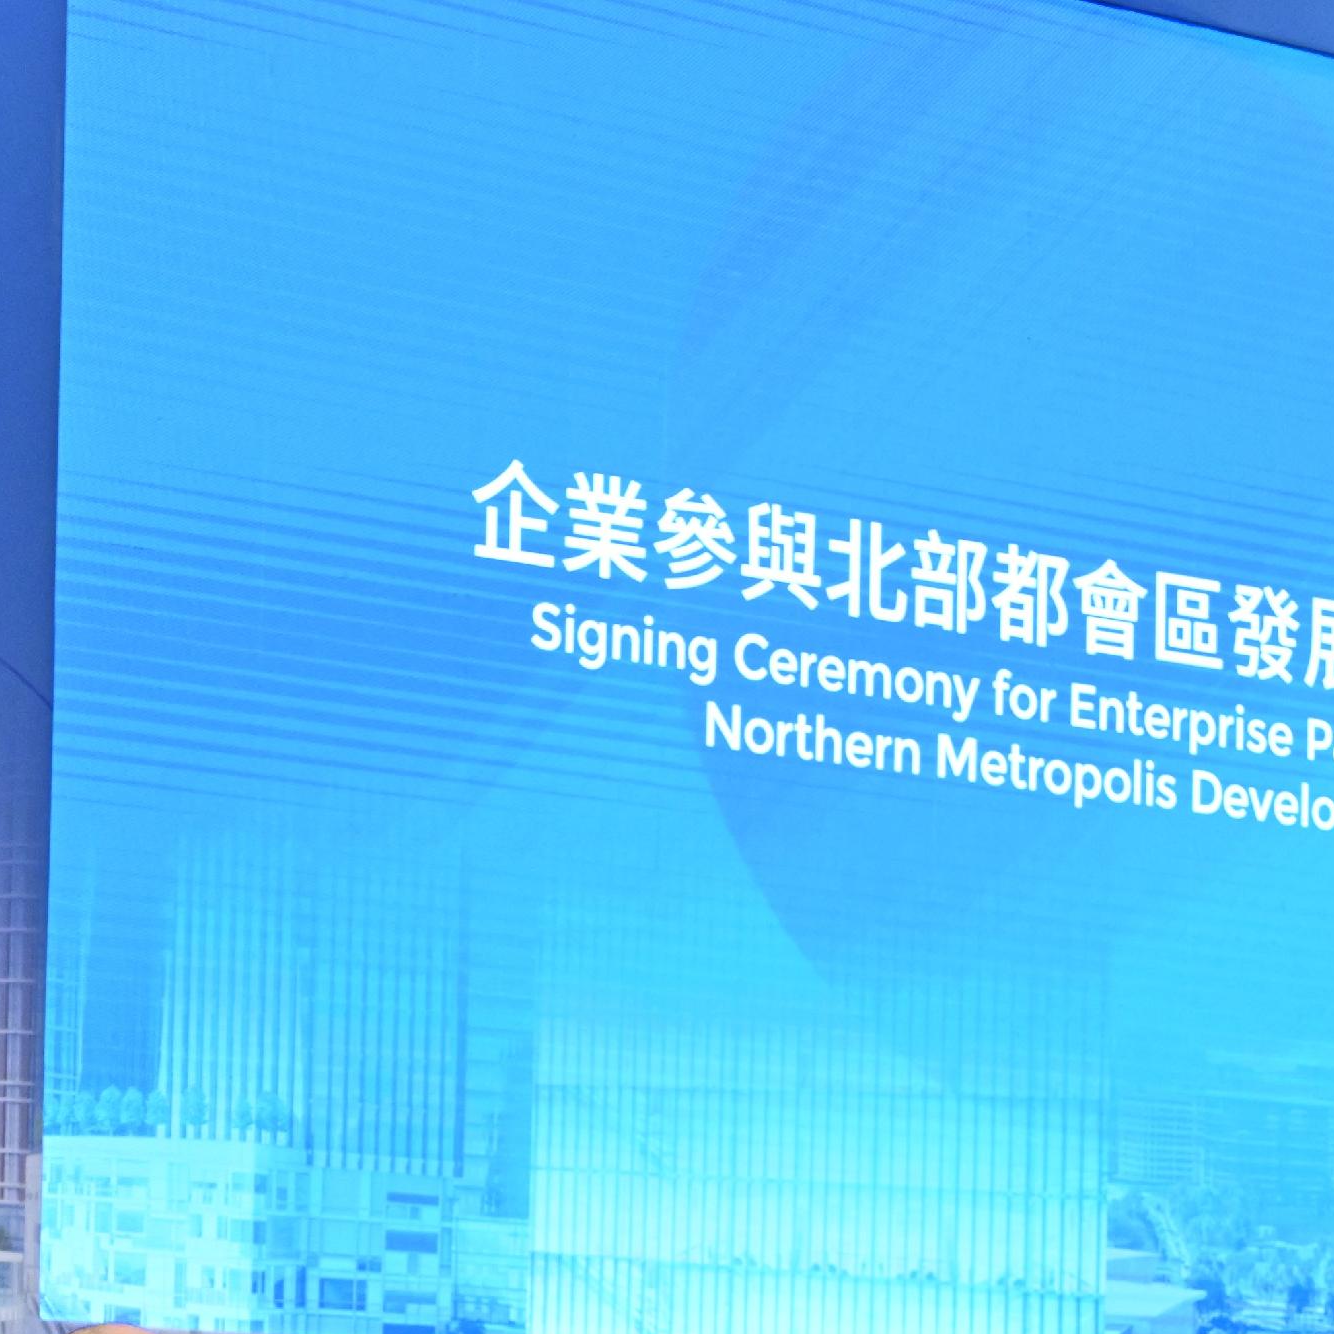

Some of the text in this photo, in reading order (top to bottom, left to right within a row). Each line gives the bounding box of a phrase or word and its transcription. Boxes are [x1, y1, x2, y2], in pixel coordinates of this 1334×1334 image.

[530, 602, 718, 686] Signing
[733, 633, 980, 722] Ceremony
[992, 668, 1057, 723] for
[1069, 683, 1294, 755] Enterprise
[705, 701, 921, 776] Northern
[936, 733, 1178, 810] Metropolis
